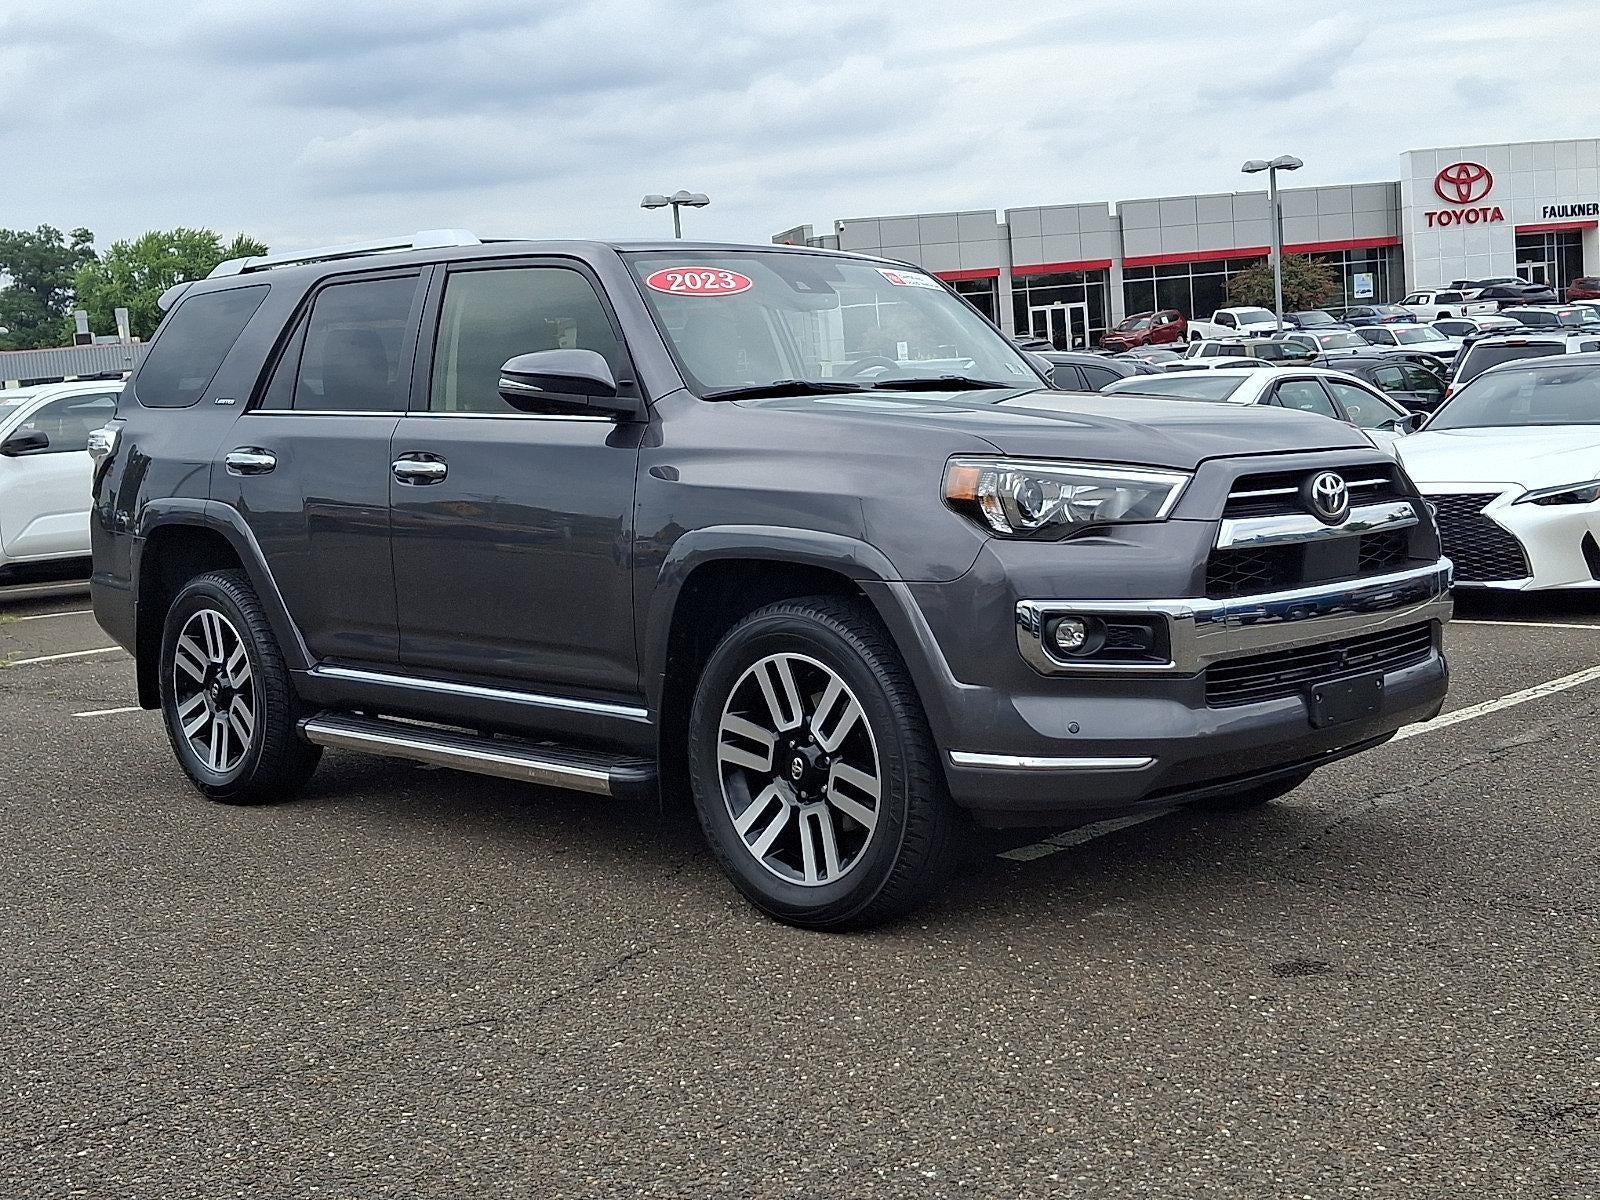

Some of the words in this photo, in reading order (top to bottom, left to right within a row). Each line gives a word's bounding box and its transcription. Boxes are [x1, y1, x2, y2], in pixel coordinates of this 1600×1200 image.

[1425, 206, 1504, 228] TOYOTA
[1542, 203, 1599, 218] FAULKNER
[666, 272, 737, 291] 2023
